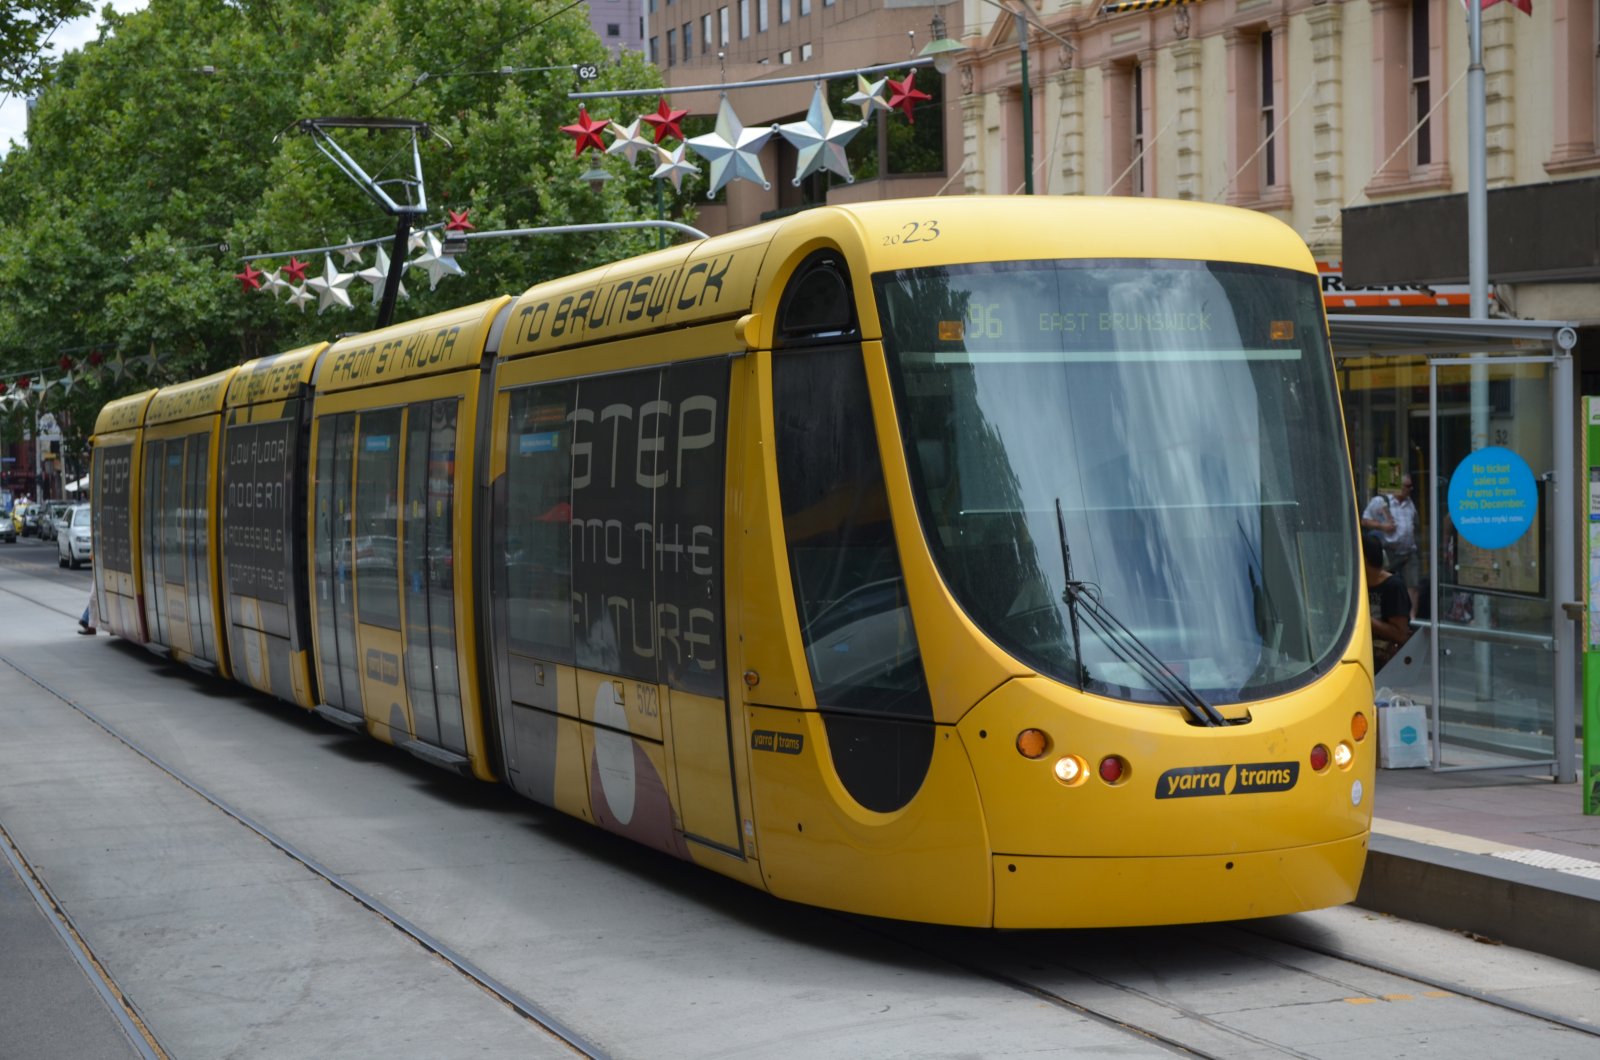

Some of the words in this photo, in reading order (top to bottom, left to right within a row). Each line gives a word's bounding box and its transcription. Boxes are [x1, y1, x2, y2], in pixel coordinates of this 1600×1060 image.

[580, 66, 597, 78] 62
[516, 302, 549, 344] TO
[551, 254, 734, 337] BRUNSWICK
[968, 303, 1003, 339] 96
[1039, 312, 1089, 332] EAST
[1099, 311, 1213, 332] BRUNSWICK
[331, 343, 376, 384] FROM
[376, 340, 403, 374] ST
[401, 326, 461, 369] KILDA
[231, 443, 248, 465] LOW
[251, 440, 285, 464] FLOOR
[566, 395, 717, 490] STEP
[103, 457, 129, 493] STEP
[1472, 464, 1485, 473] No
[1486, 464, 1511, 473] ticket
[1473, 476, 1497, 485] sales
[1498, 477, 1510, 485] on
[229, 481, 283, 508] MODERN
[1459, 500, 1479, 510] 29th
[1466, 488, 1493, 497] trams
[1495, 488, 1517, 496] from
[1460, 516, 1482, 524] Switch
[1491, 516, 1508, 524] myki
[229, 525, 282, 551] ACCESSIBLE
[634, 522, 713, 575] THE
[571, 591, 716, 671] FUTURE
[637, 683, 658, 718] 5123
[754, 735, 773, 747] yarra
[779, 736, 800, 750] trams
[1168, 772, 1221, 795] yarra
[1240, 768, 1291, 786] trams
